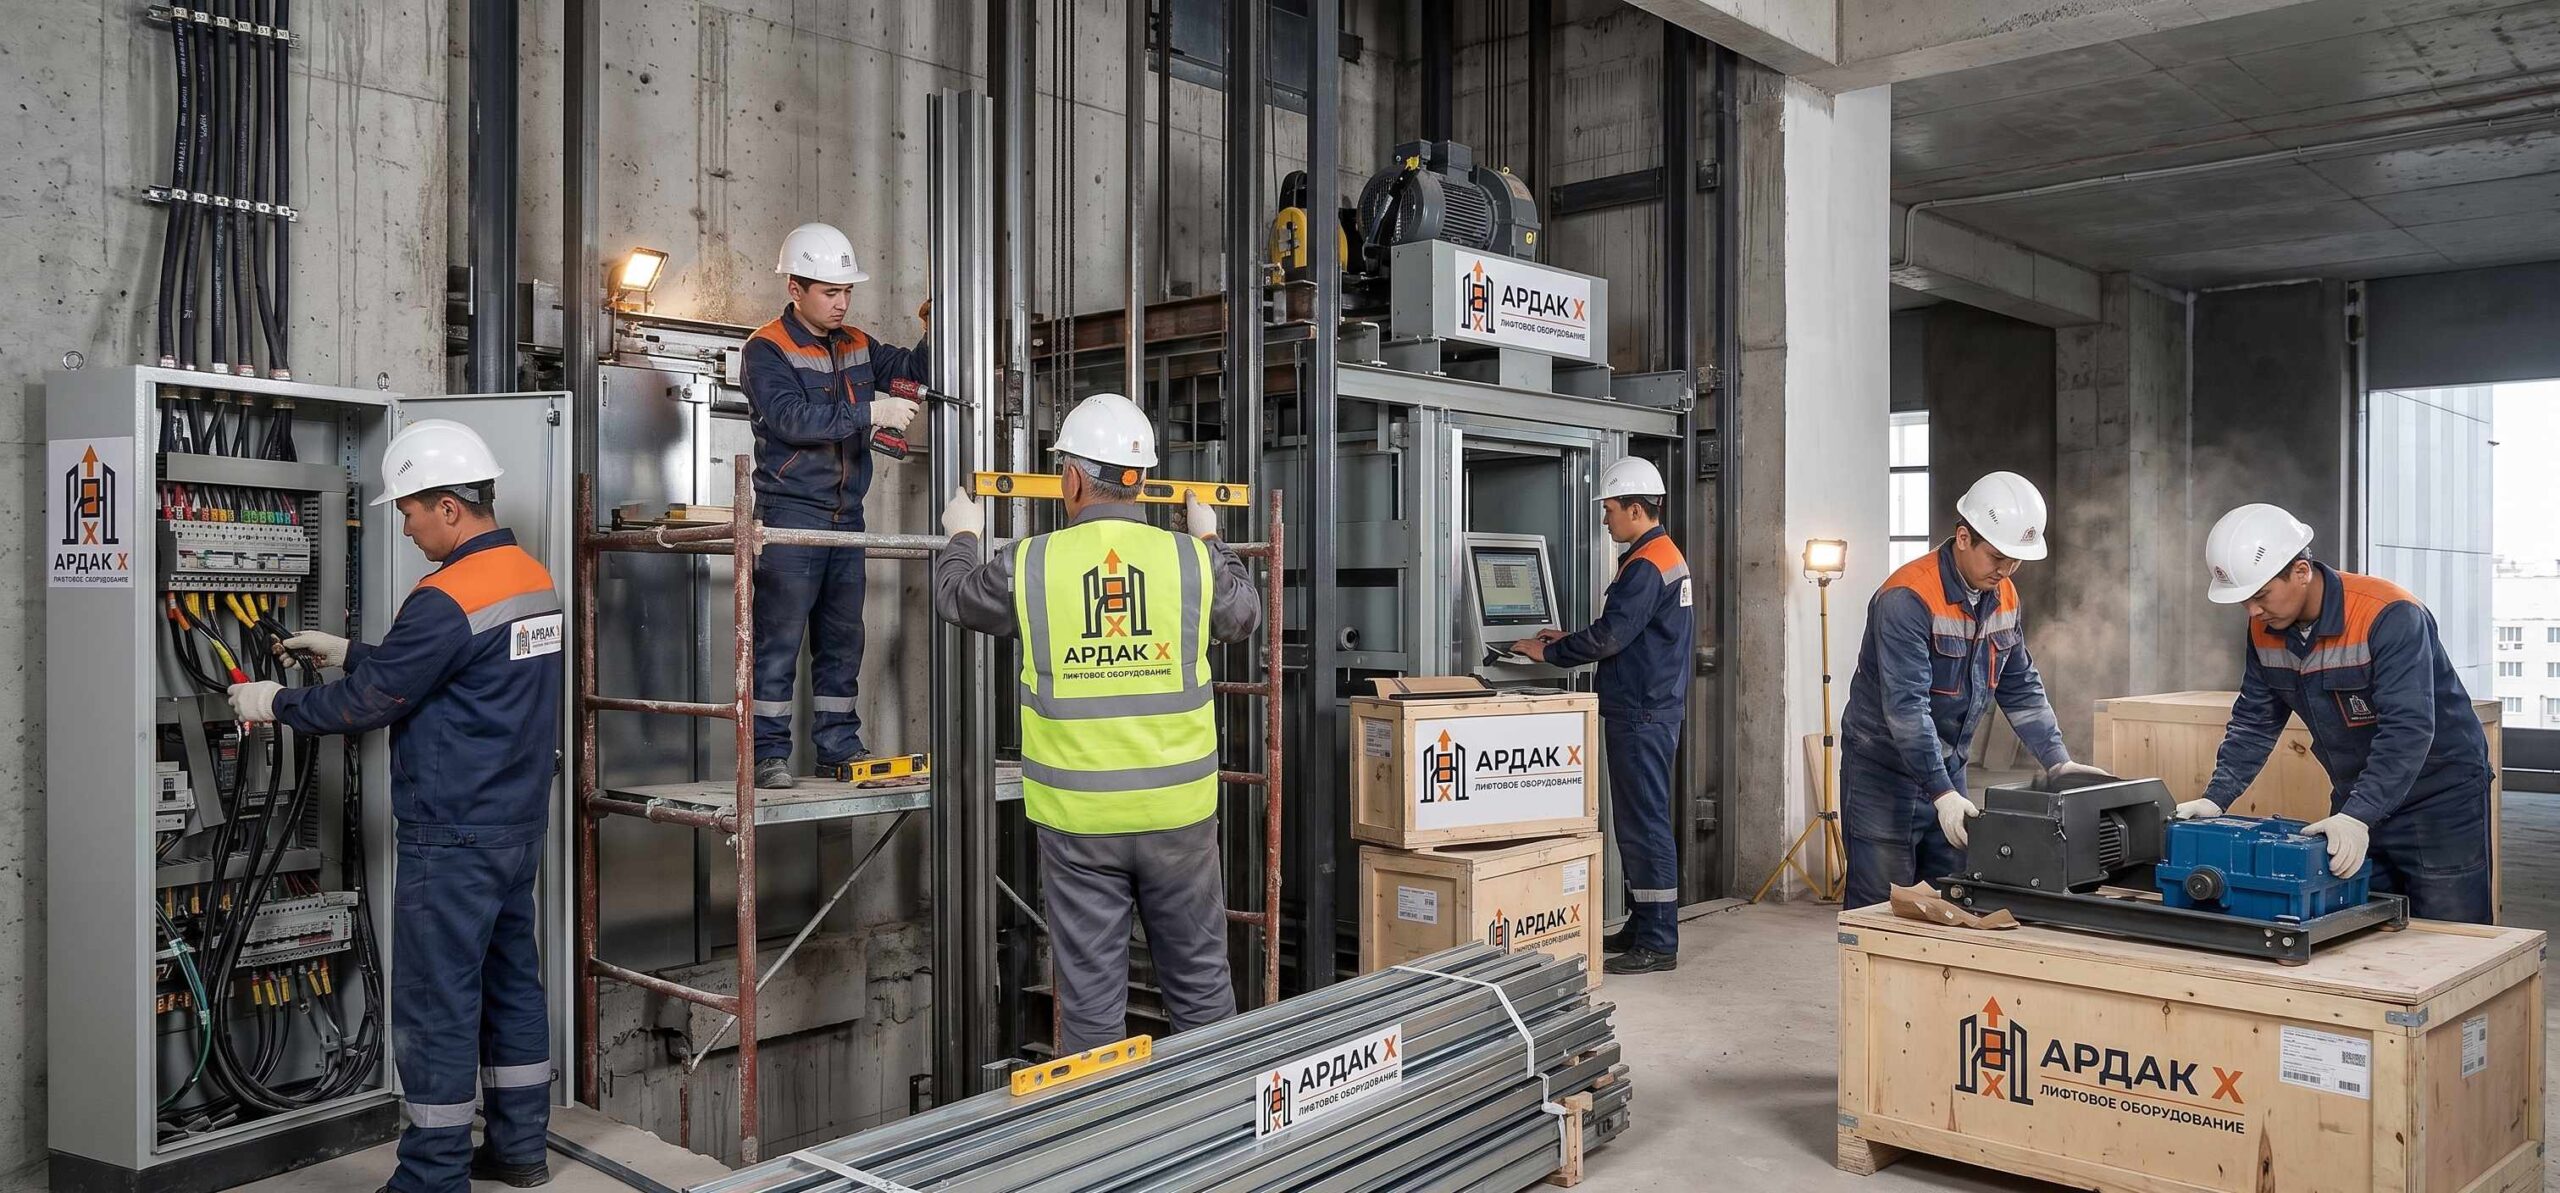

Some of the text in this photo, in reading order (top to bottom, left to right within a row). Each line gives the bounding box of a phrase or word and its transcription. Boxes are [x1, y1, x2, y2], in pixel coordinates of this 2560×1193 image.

[1501, 285, 1585, 321] АРДАК Х
[54, 553, 128, 574] АРДАК Х
[1063, 642, 1171, 666] АРДАК Х
[1475, 745, 1582, 774] АРДАК Х
[1514, 907, 1567, 938] АРДАК
[1298, 1034, 1398, 1094] АРДАК Х
[2040, 1038, 2245, 1105] АРДАК Х
[2040, 1084, 2246, 1135] ЛИФТОВОЕ ОБОРУДОВАНИЕ
